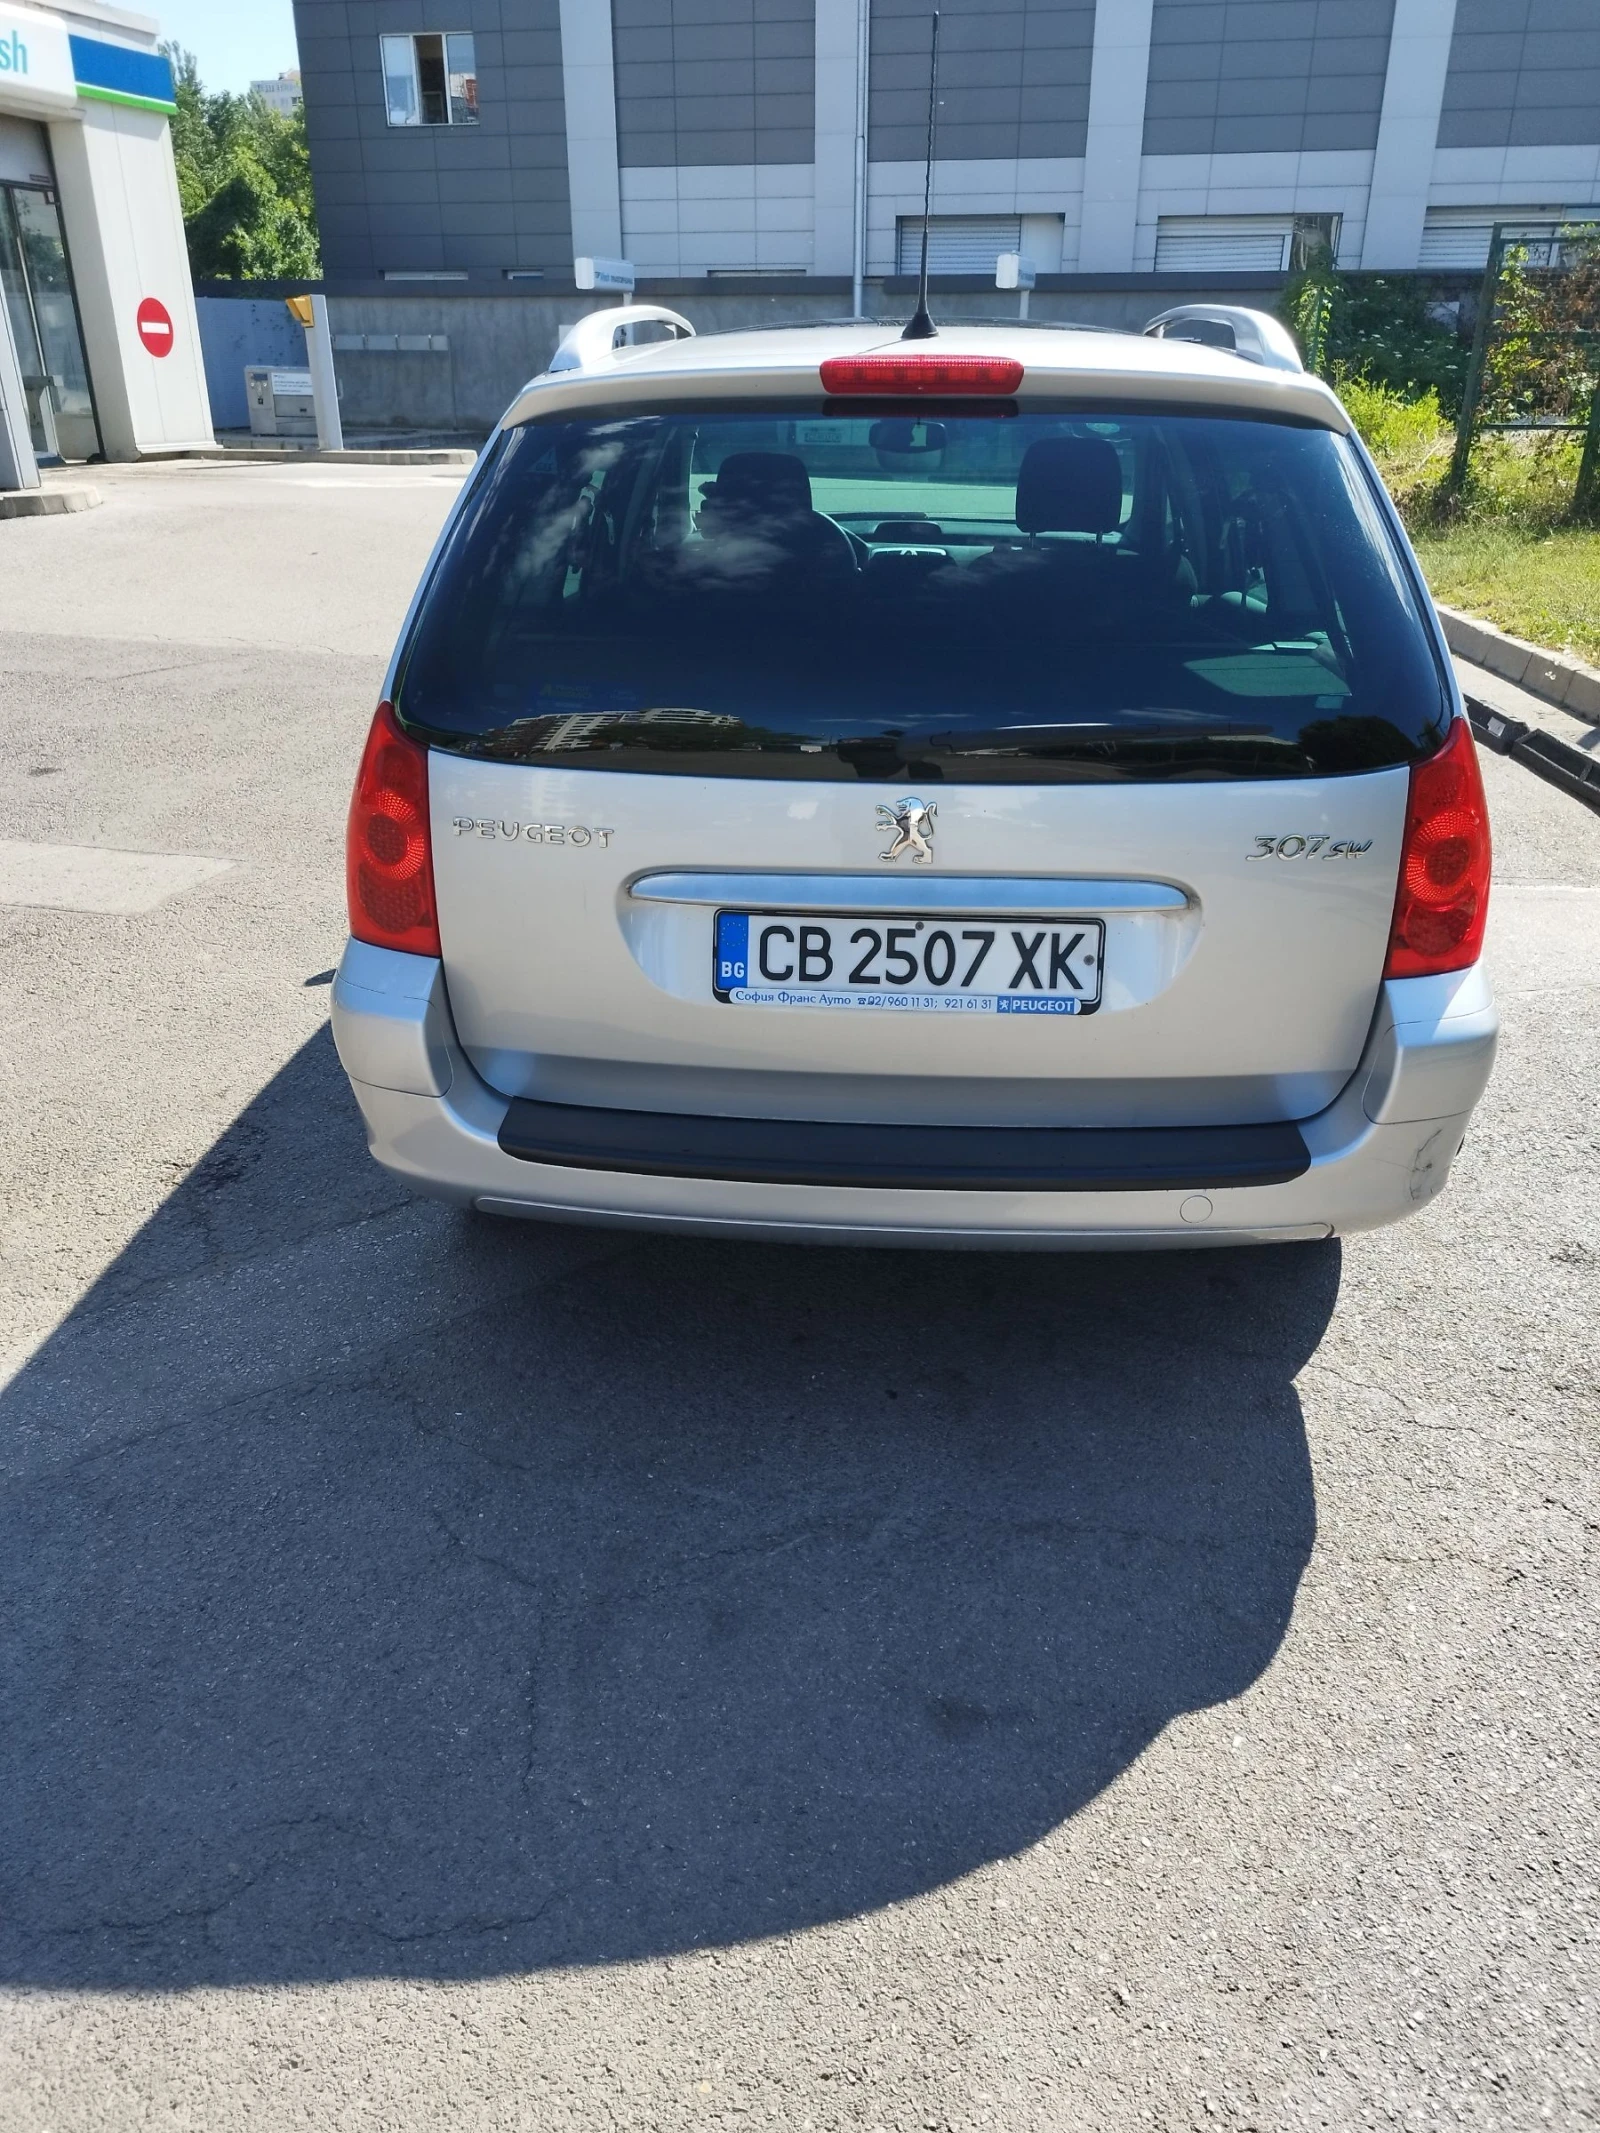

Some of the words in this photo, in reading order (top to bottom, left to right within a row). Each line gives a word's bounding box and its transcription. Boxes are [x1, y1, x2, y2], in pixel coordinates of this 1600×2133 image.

[453, 816, 614, 848] PEUGEOT
[759, 925, 833, 982] CB
[849, 928, 995, 987] 2507
[1008, 931, 1085, 989] XK
[721, 961, 745, 978] BG
[735, 990, 774, 1004] София
[777, 991, 817, 1005] Франс
[944, 999, 963, 1009] 921
[967, 999, 977, 1010] 61
[981, 999, 992, 1010] 31
[1012, 999, 1074, 1012] PEUGEOT
